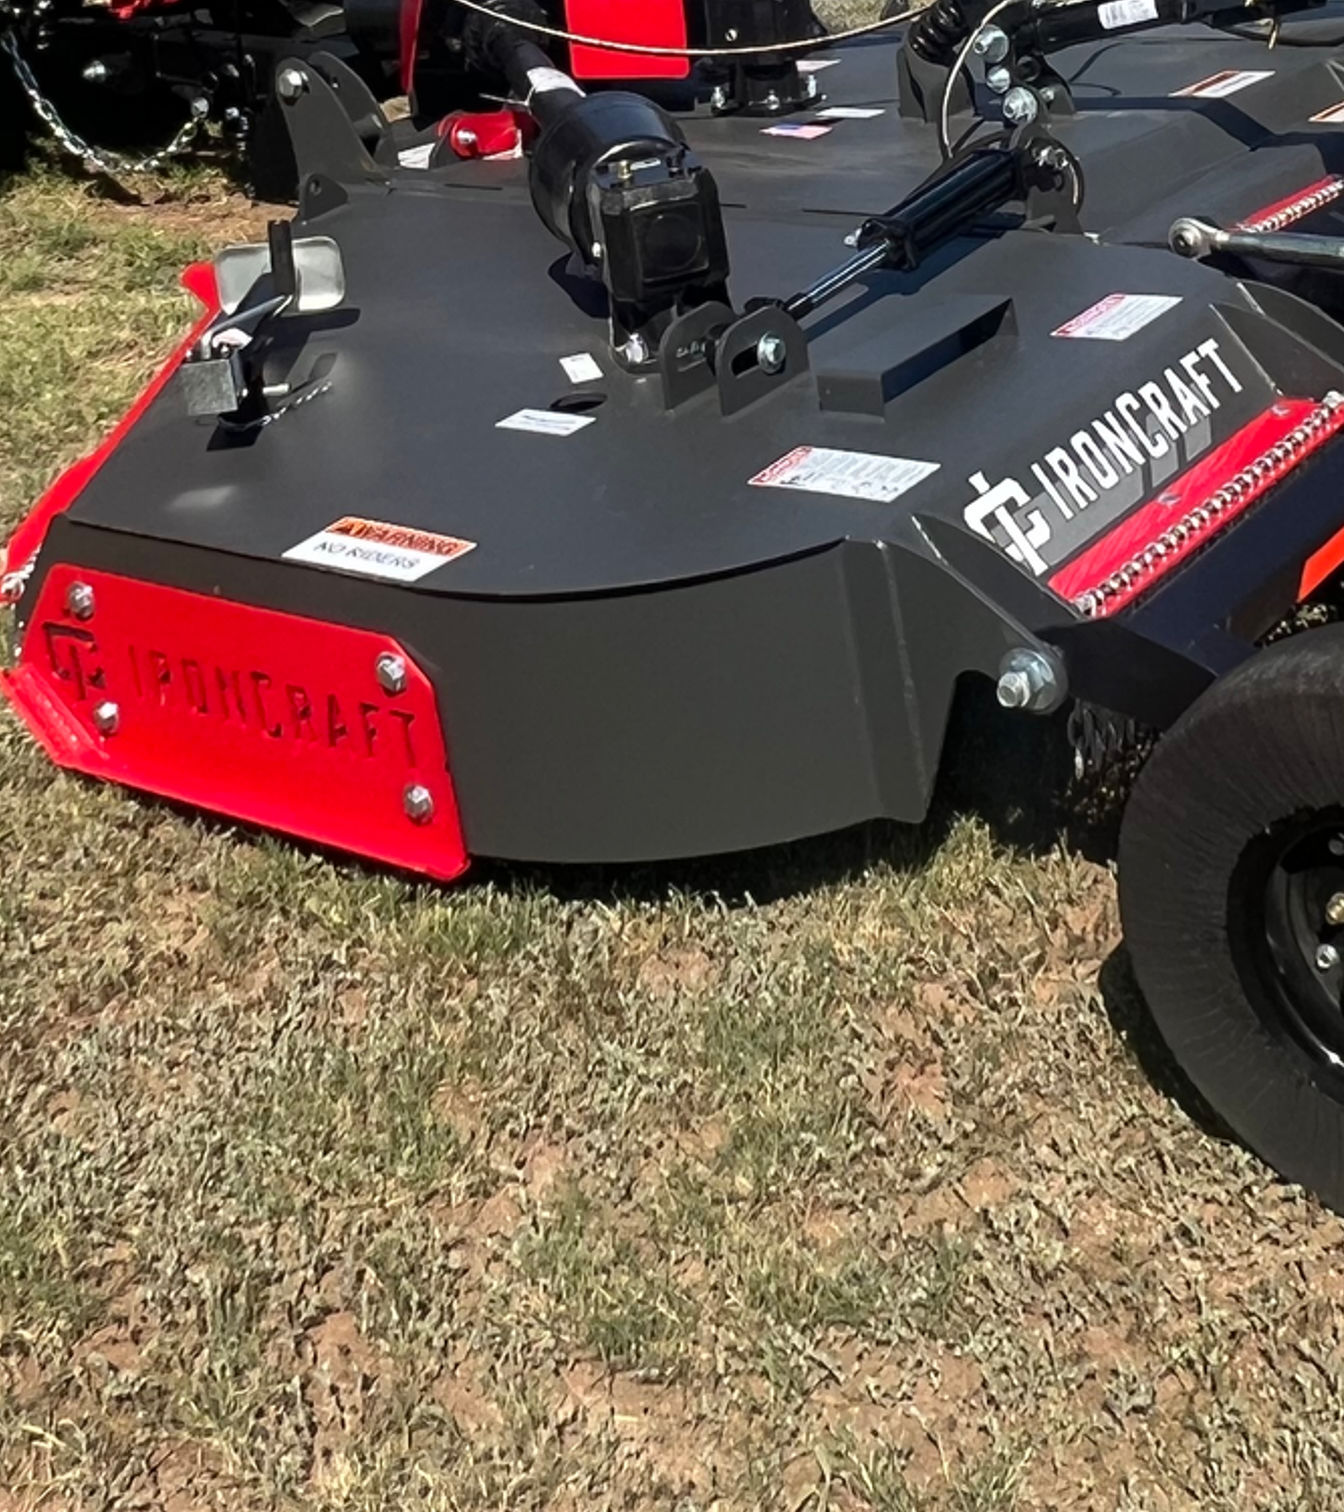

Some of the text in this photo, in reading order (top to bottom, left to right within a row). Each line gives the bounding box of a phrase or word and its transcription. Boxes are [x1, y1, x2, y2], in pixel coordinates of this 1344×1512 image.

[1030, 336, 1244, 522] IRONCRAFT
[313, 541, 422, 570] NO RIDERS
[356, 522, 460, 556] WARNING
[129, 645, 414, 767] IRONCRAFT
